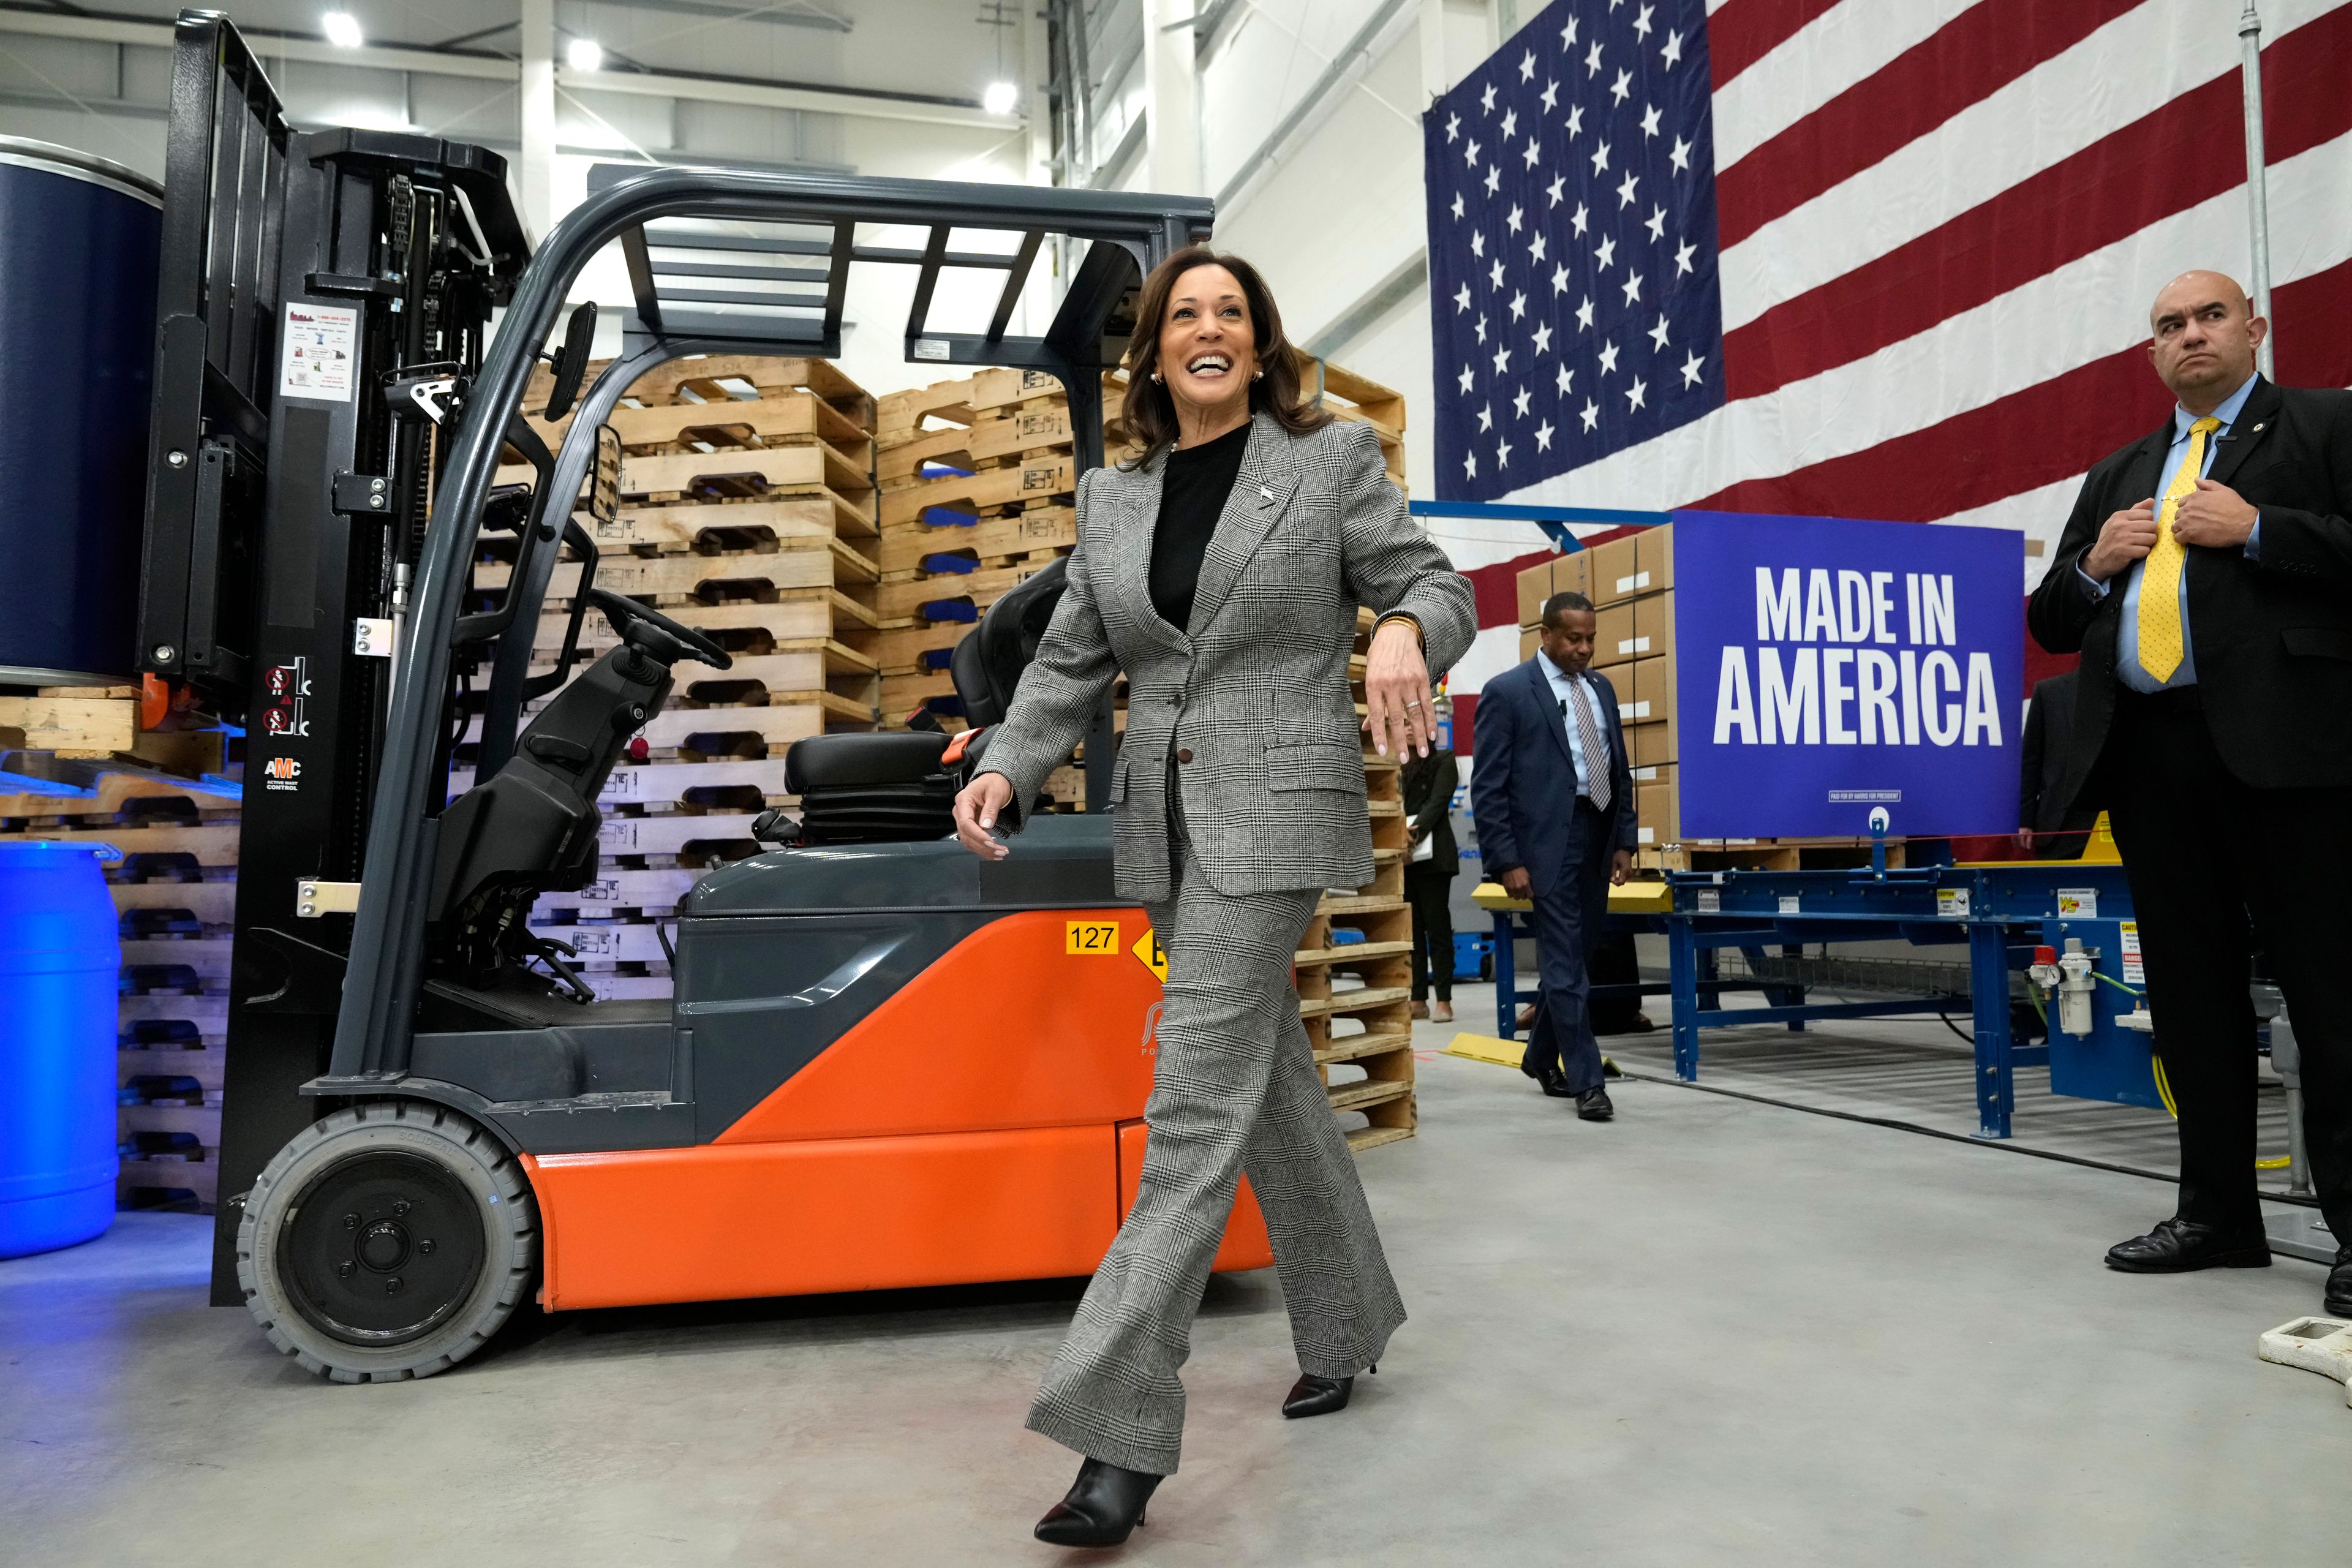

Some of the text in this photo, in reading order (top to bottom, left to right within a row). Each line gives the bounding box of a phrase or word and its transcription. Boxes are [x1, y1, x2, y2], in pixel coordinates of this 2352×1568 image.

[1755, 567, 1956, 646] MADE IN
[1713, 646, 2002, 747] AMERICA
[264, 758, 301, 778] AMC
[1072, 927, 1114, 948] 127
